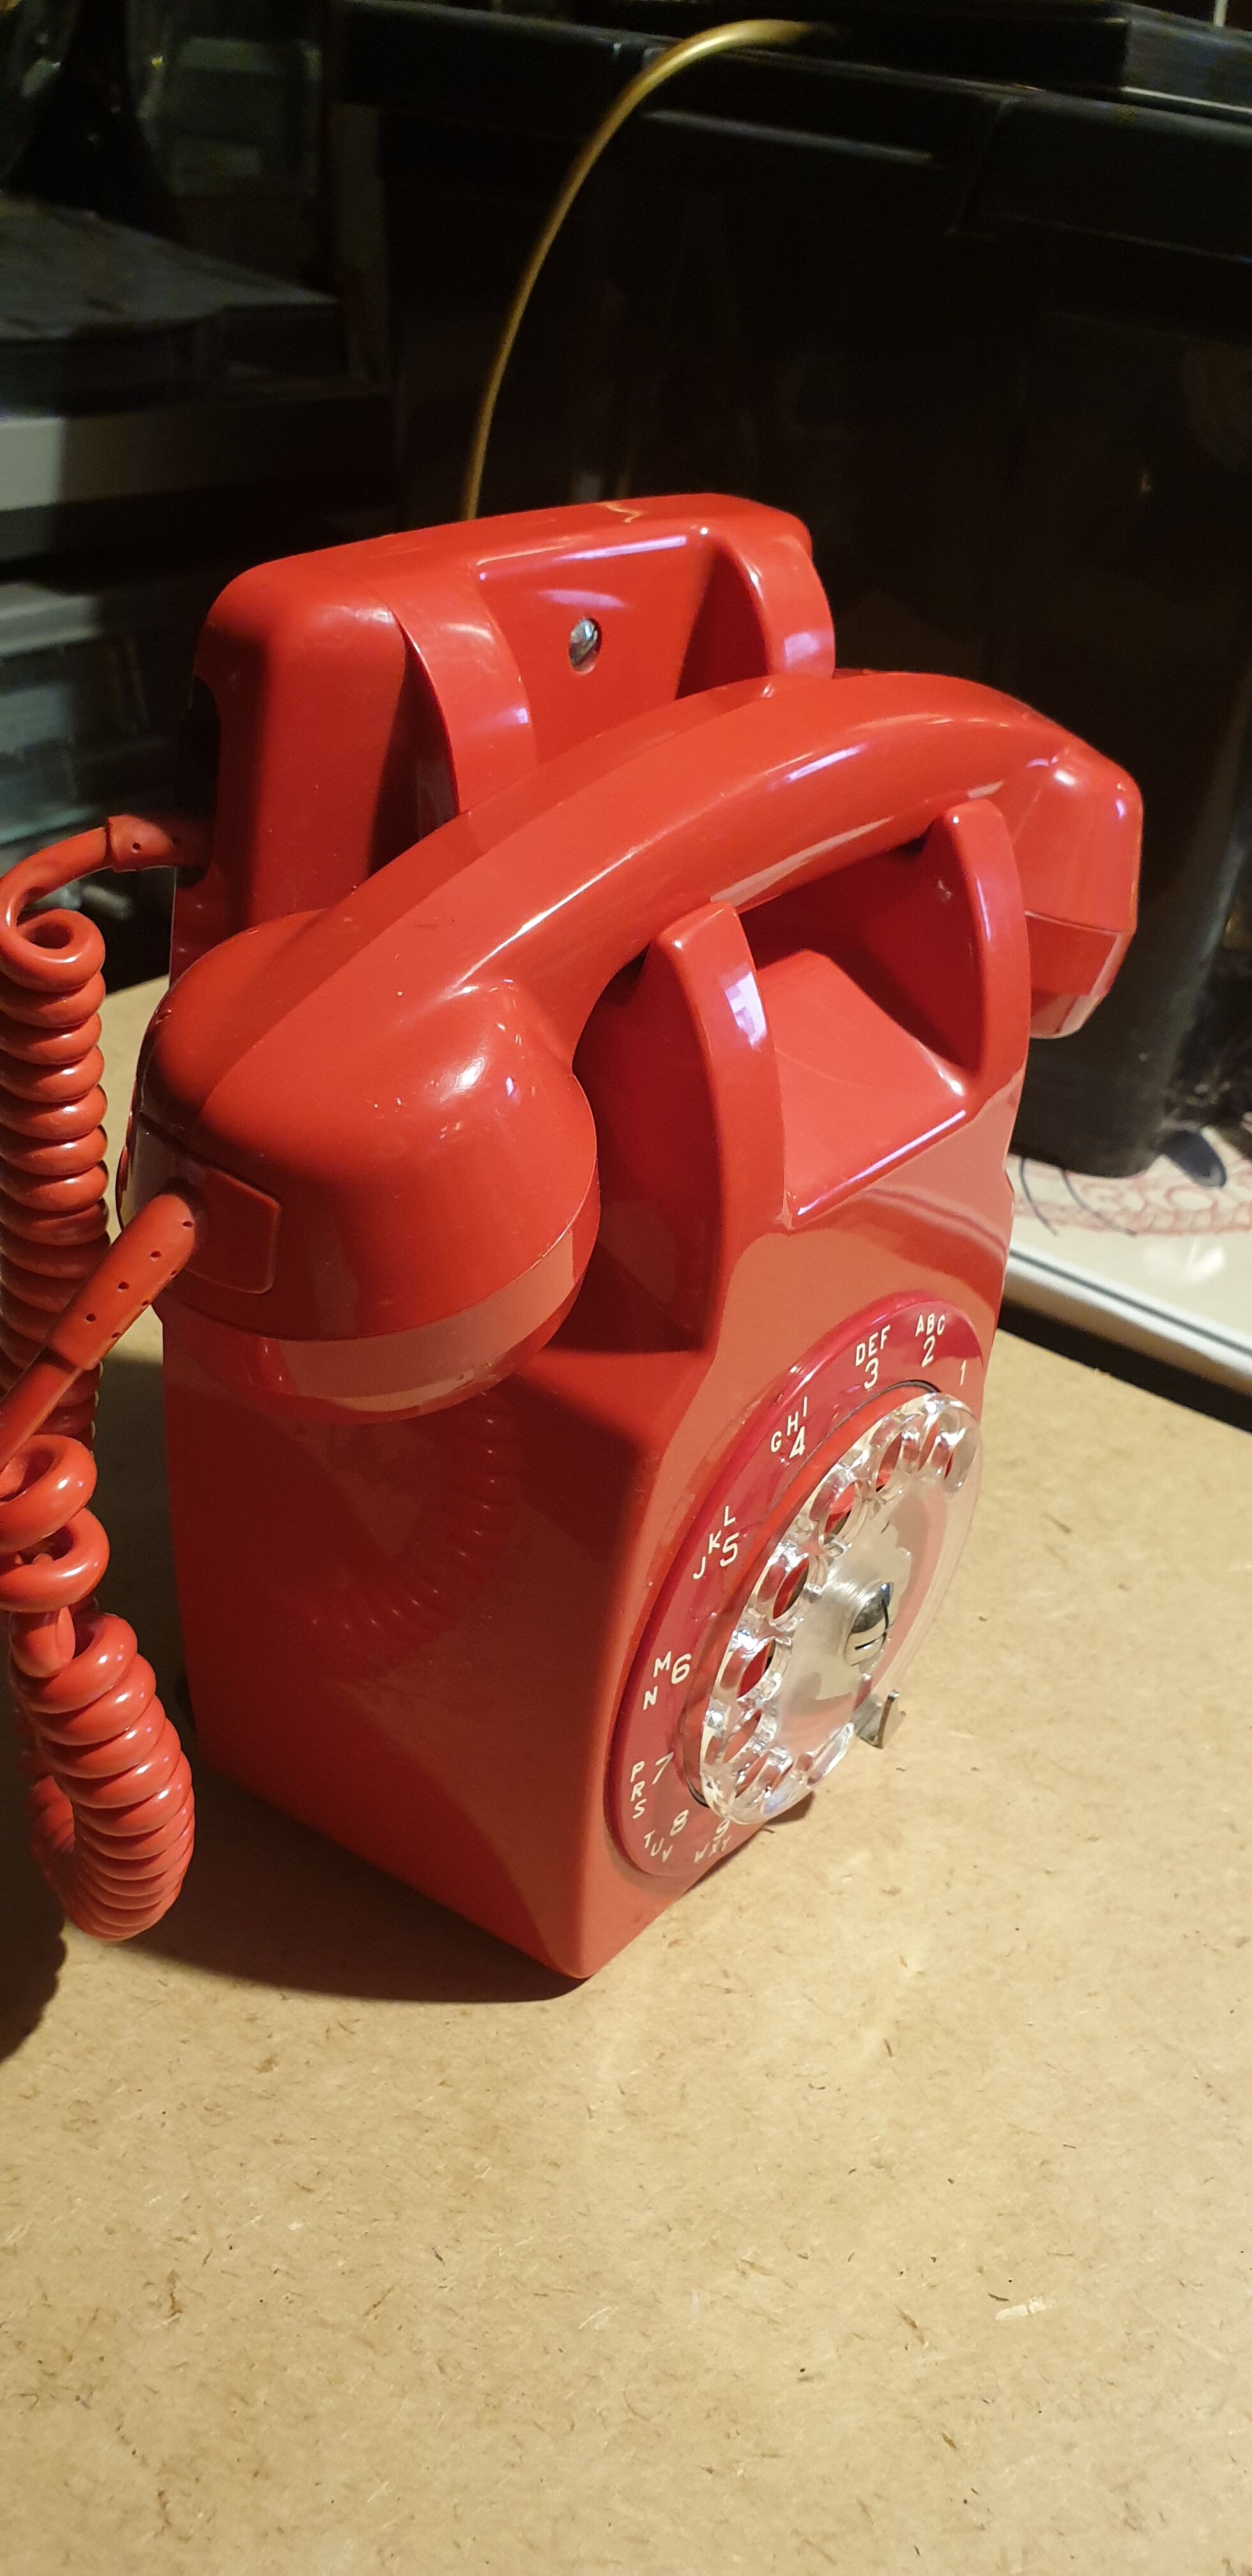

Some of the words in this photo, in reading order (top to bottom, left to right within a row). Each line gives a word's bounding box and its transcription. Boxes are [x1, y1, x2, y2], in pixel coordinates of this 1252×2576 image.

[914, 1312, 946, 1337] ABC
[855, 1324, 891, 1367] DEF
[920, 1335, 935, 1368] 2
[863, 1357, 880, 1390] 3
[959, 1359, 967, 1387] 1
[770, 1395, 808, 1453] GHI
[789, 1425, 805, 1459] 4
[719, 1532, 740, 1567] 5
[643, 1650, 672, 1711] MN
[671, 1653, 692, 1685] 6
[652, 1751, 675, 1786] 7
[629, 1760, 648, 1820] PRS
[669, 1809, 689, 1836] 8
[712, 1818, 731, 1841] 9
[643, 1830, 674, 1863] TUV
